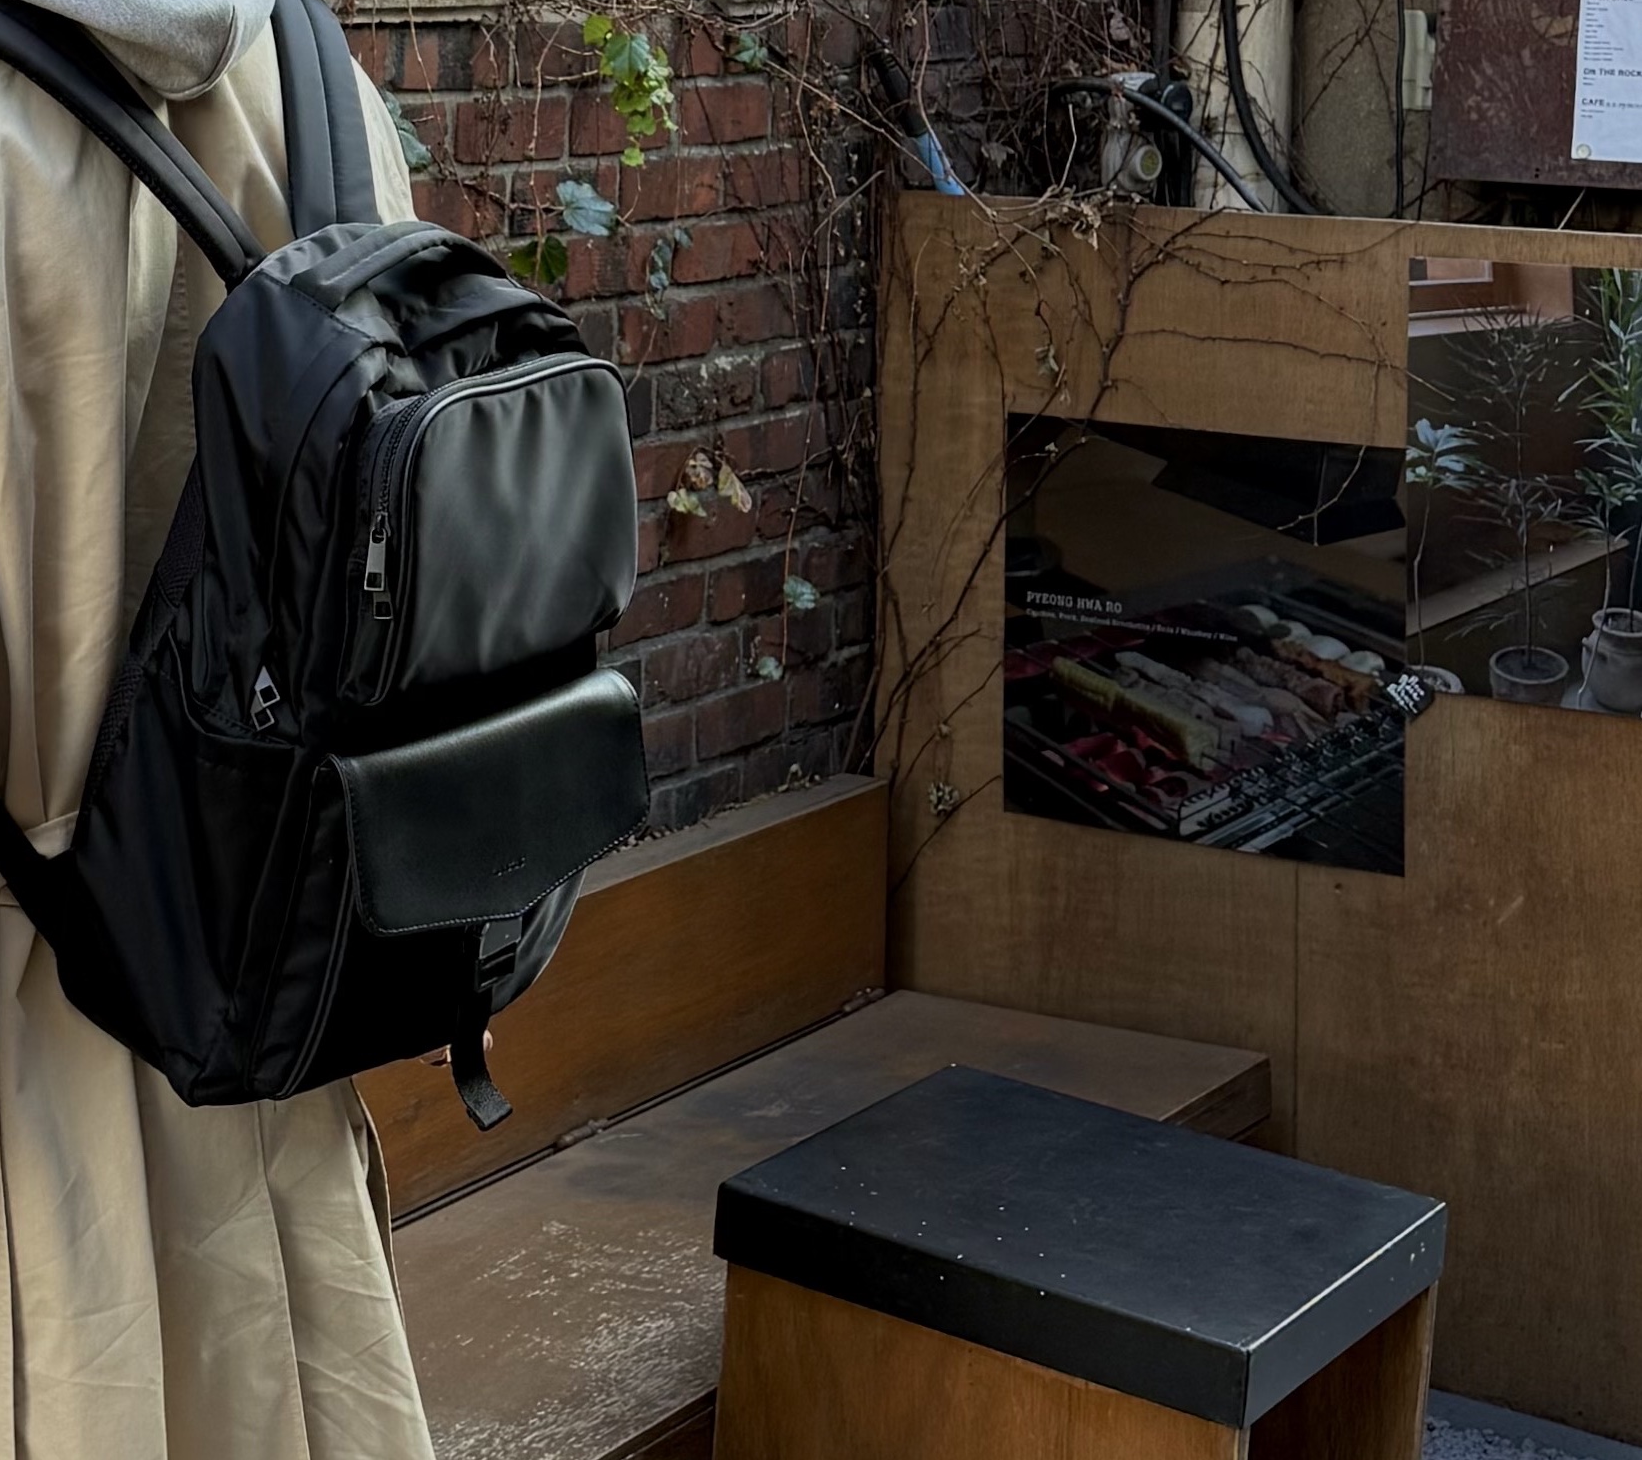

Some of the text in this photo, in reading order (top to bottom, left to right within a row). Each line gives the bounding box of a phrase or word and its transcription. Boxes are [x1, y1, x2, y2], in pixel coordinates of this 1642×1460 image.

[1026, 590, 1123, 614] PYEONG HWA RO
